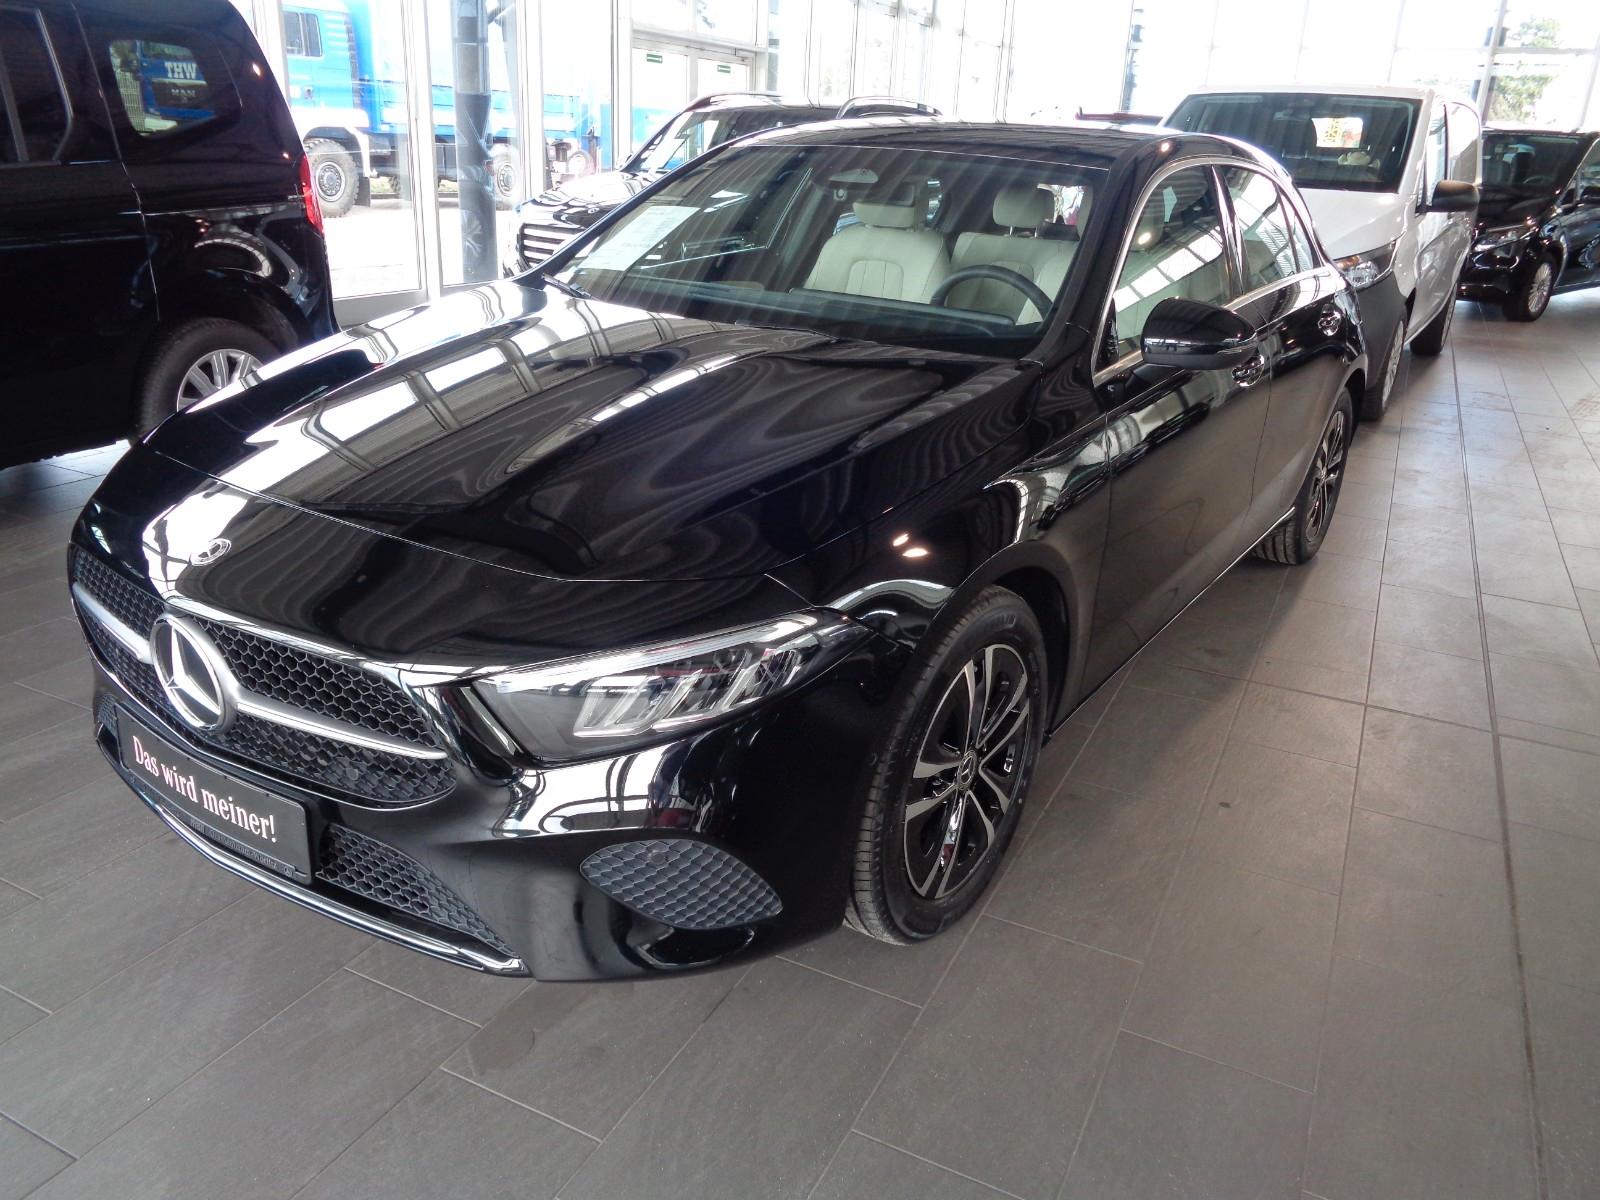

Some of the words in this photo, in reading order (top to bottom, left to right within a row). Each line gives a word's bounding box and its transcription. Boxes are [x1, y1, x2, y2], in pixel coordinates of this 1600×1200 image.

[164, 61, 198, 79] THW
[132, 735, 159, 777] Das
[160, 763, 198, 803] wird
[201, 788, 277, 843] meiner!
